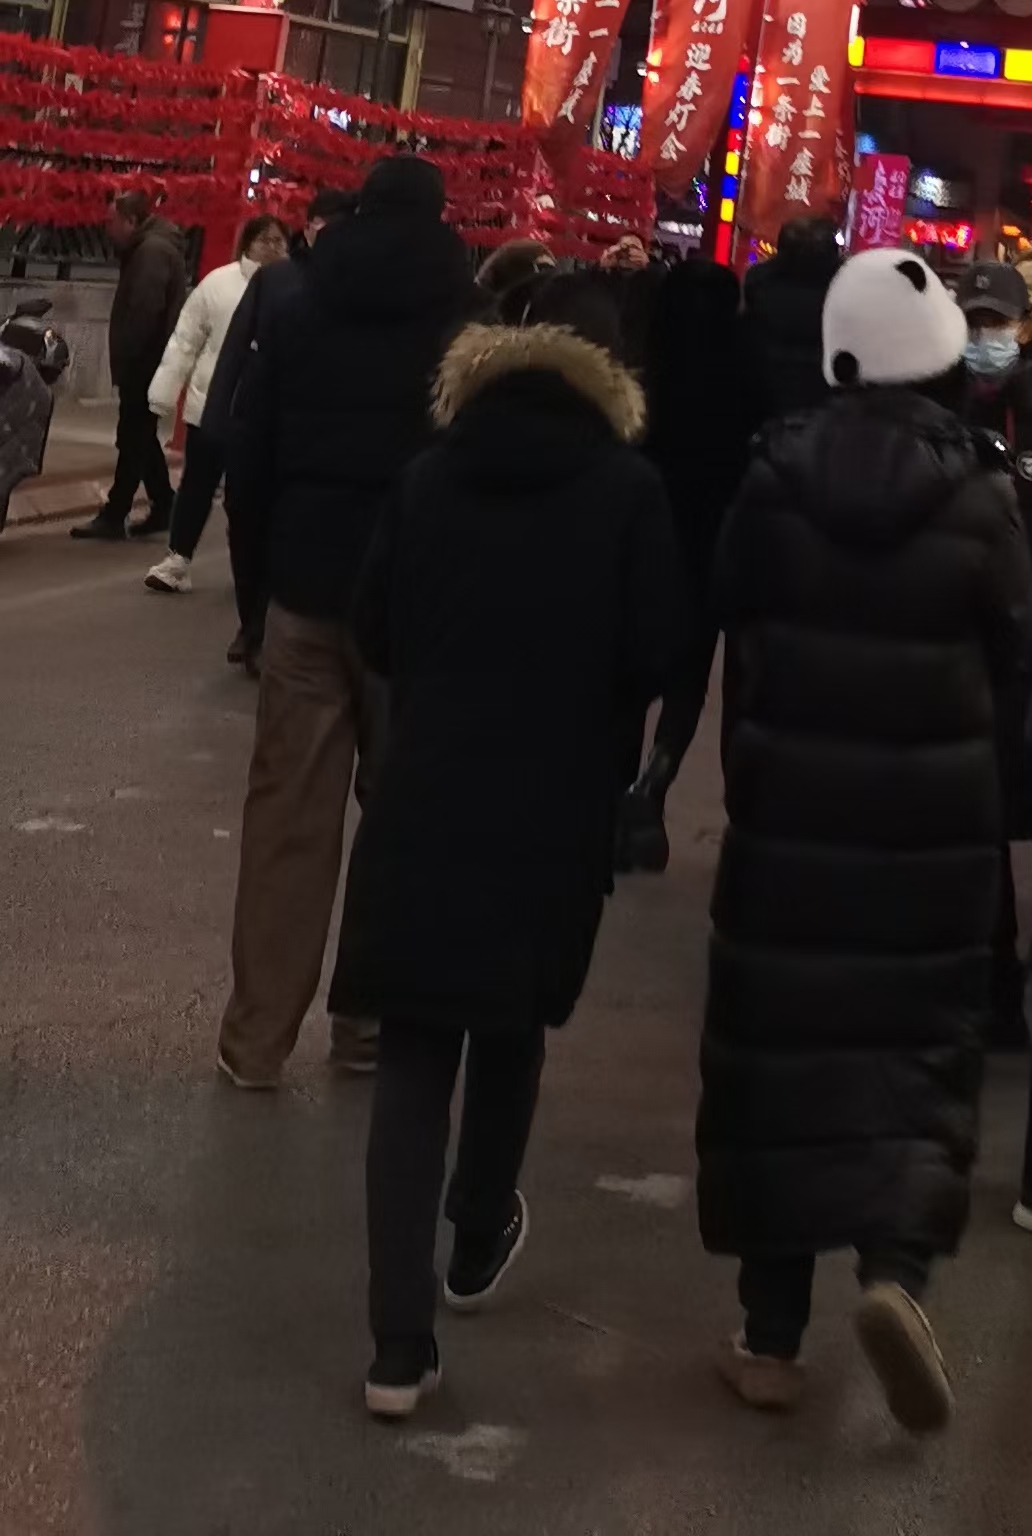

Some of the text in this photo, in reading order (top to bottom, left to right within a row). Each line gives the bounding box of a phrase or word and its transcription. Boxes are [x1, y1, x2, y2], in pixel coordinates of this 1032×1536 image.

[765, 12, 807, 151] 因为一条街
